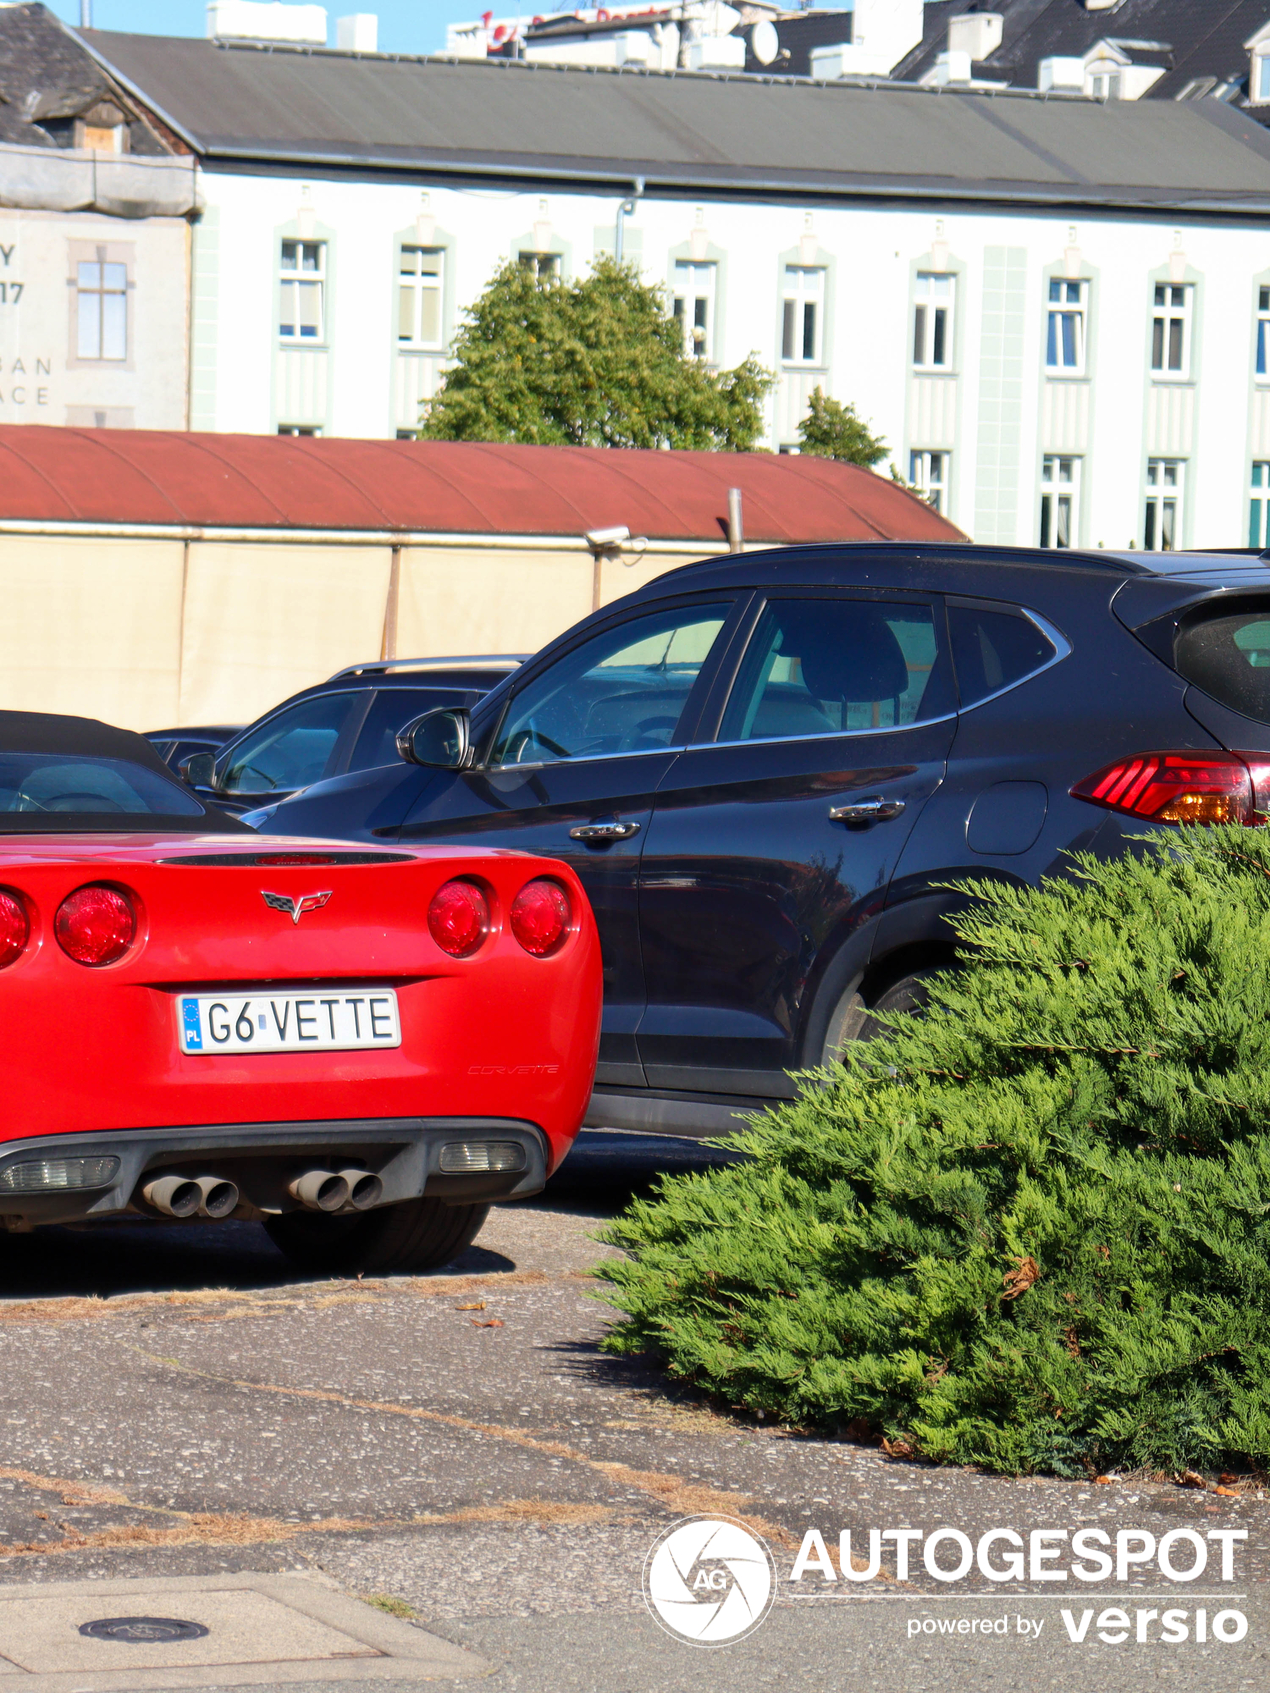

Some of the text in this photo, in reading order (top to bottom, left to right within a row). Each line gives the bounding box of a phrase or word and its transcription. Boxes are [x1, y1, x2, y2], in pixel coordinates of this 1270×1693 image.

[208, 998, 393, 1043] G6 VETTE
[186, 1031, 200, 1042] PL
[467, 1064, 560, 1074] CORVETTE
